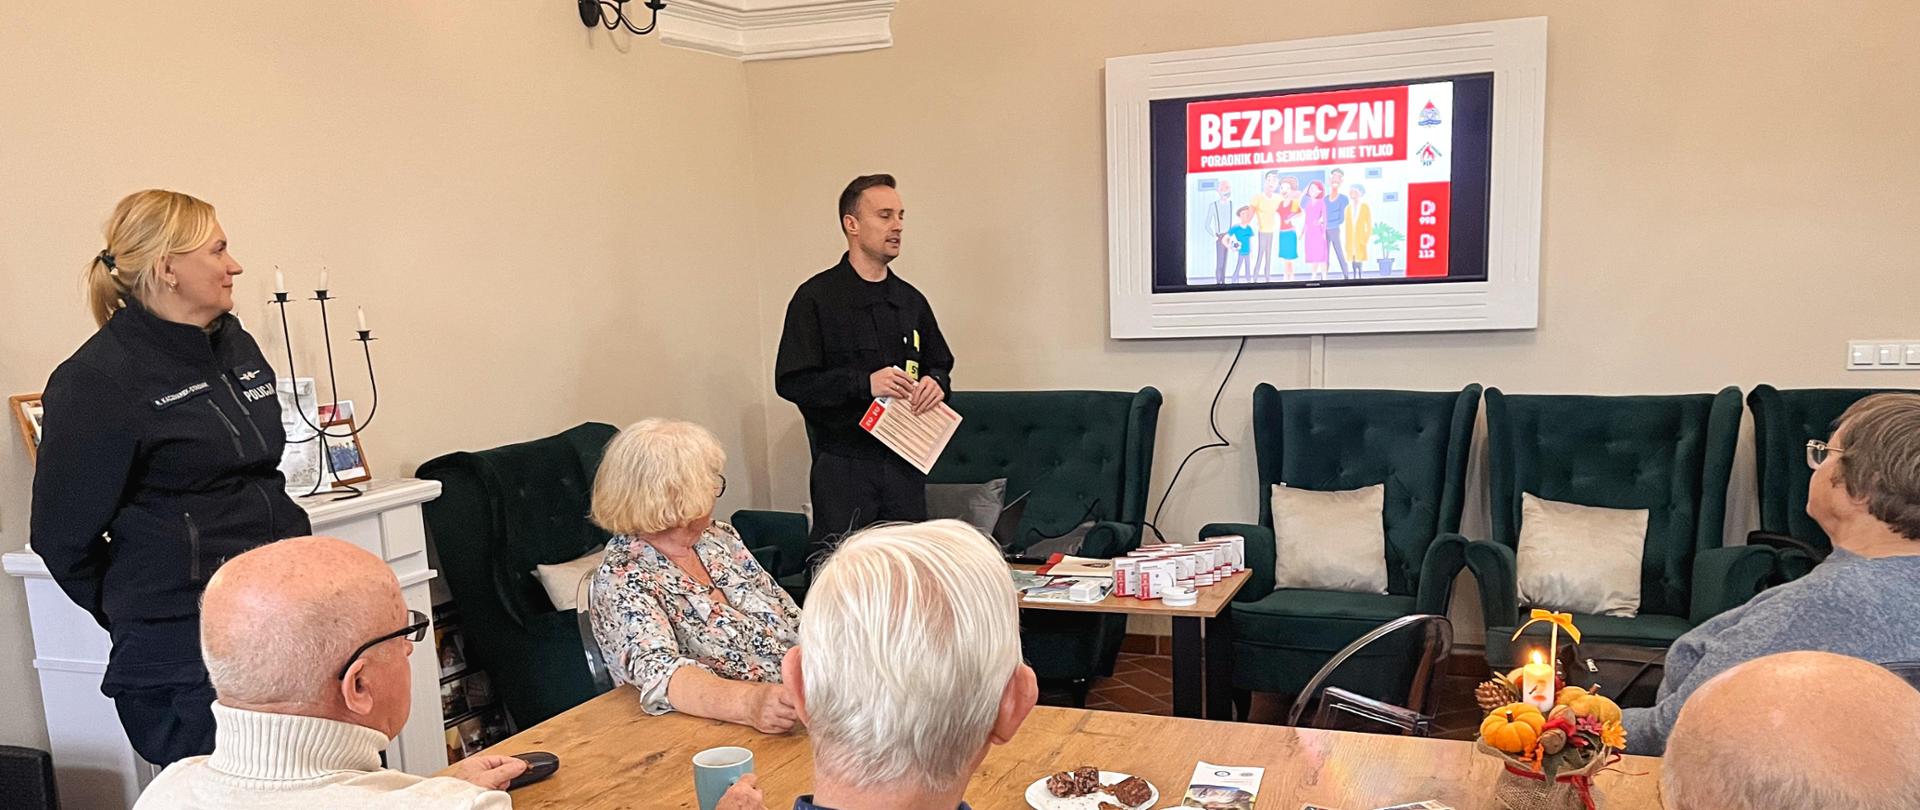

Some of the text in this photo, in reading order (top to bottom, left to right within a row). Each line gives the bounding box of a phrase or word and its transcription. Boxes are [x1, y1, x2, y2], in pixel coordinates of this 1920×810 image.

[1200, 100, 1395, 150] BEZPIECZNI
[1201, 143, 1394, 168] PORADNIK DLA SENIORÓW I NIE TYLKO
[1418, 249, 1435, 259] 112
